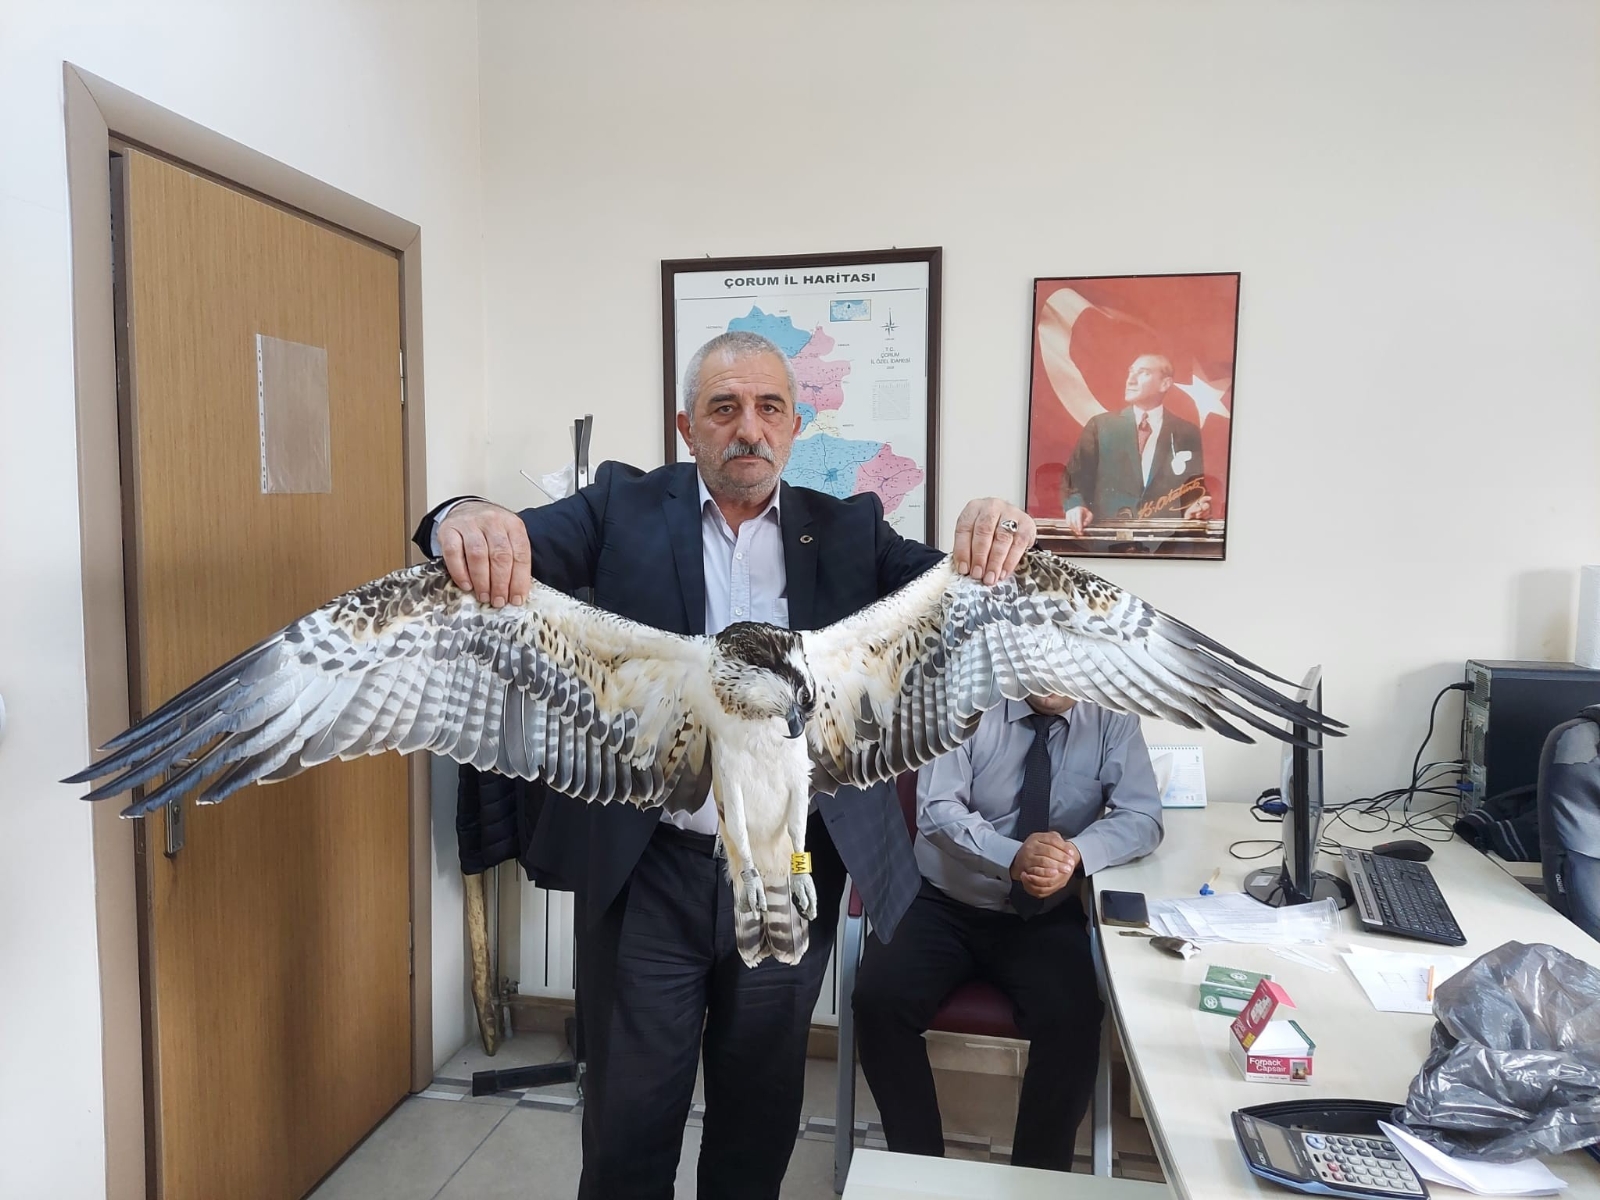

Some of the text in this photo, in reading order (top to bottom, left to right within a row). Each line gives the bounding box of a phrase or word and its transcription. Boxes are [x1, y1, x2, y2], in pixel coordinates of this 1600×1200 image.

[724, 272, 876, 289] ÇORUM İL HARİTASI
[1249, 1057, 1282, 1066] Forpack
